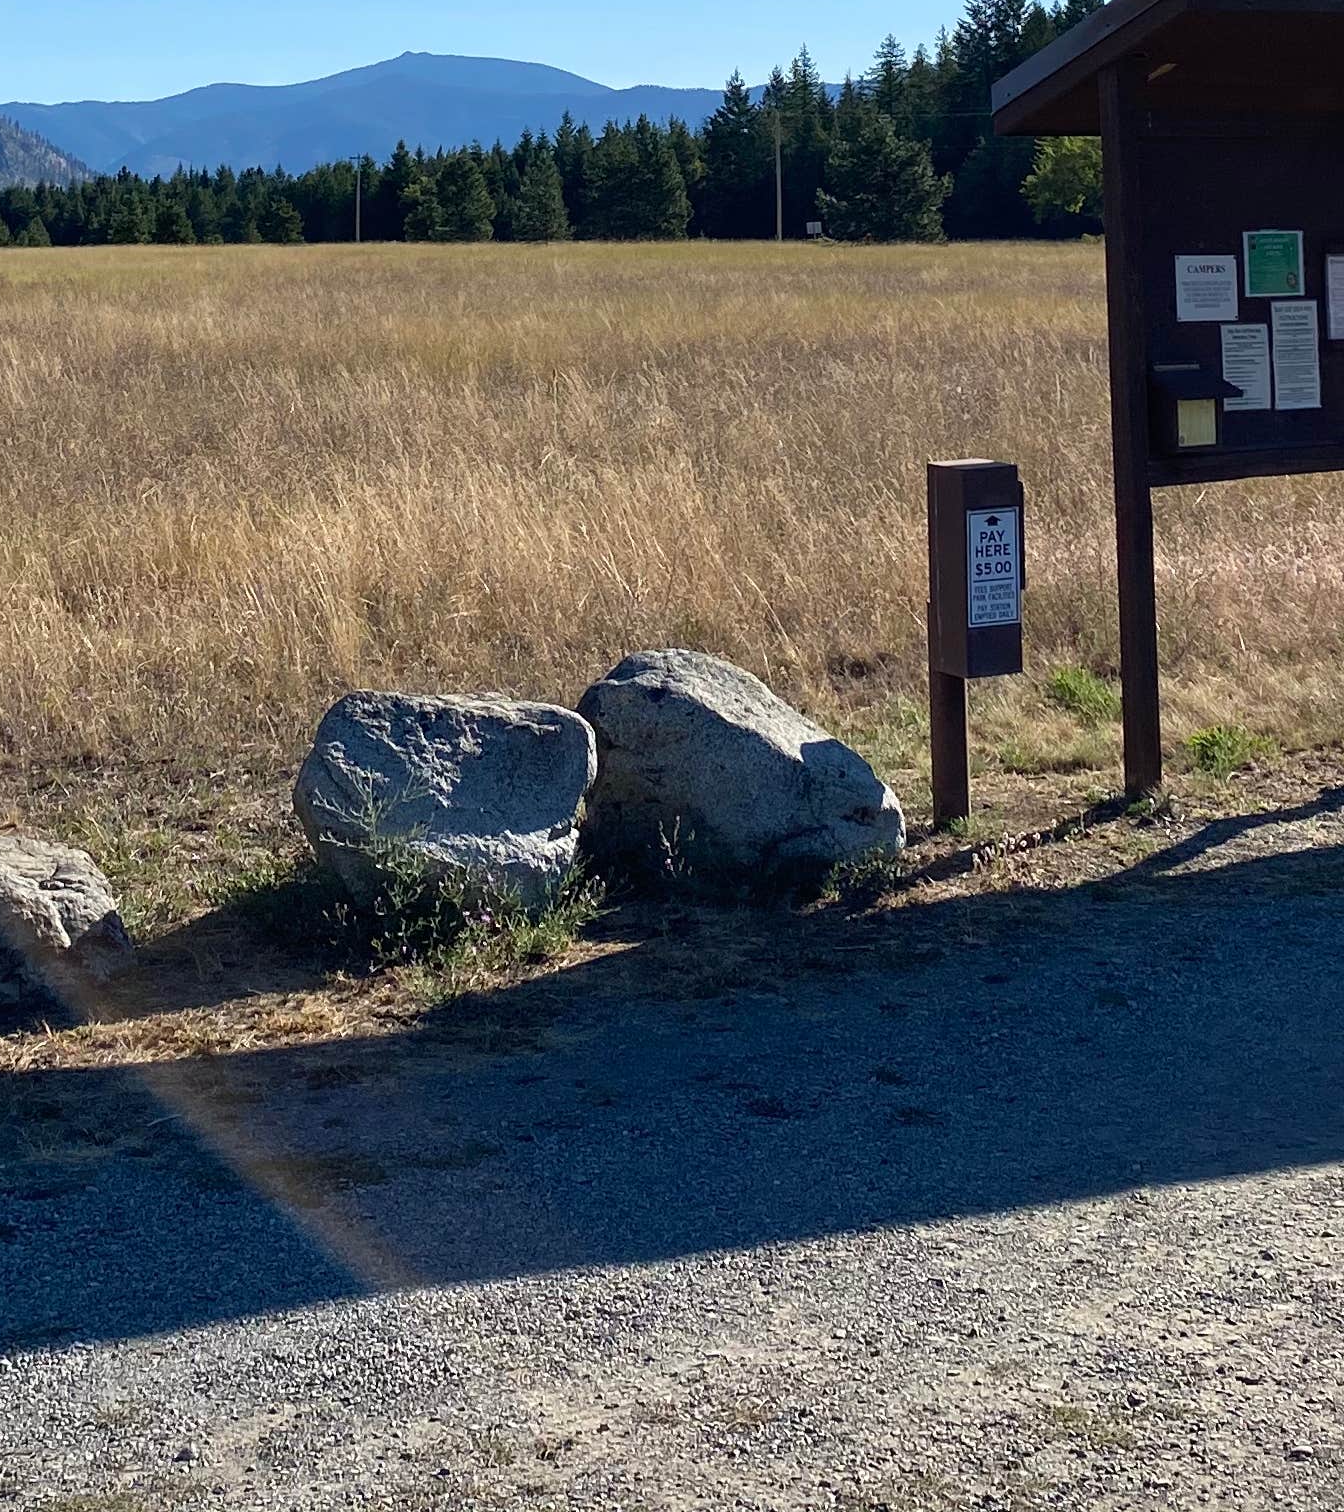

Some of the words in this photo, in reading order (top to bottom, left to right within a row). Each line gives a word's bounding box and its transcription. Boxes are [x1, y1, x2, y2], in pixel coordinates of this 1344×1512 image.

[1186, 264, 1226, 274] CAMPERS
[979, 529, 1006, 544] PAY
[975, 543, 1011, 558] HERE
[975, 560, 1012, 577] $5.00
